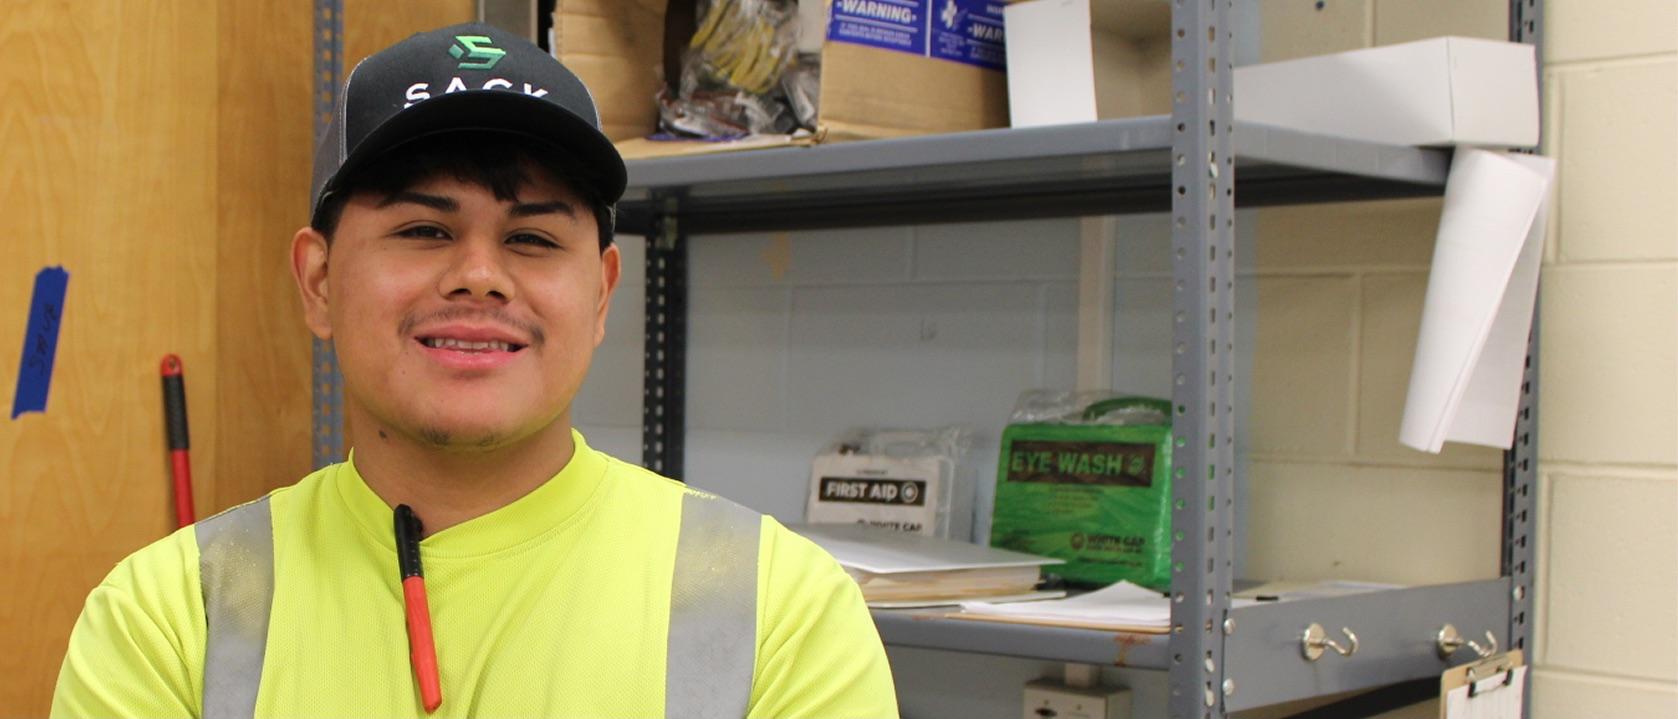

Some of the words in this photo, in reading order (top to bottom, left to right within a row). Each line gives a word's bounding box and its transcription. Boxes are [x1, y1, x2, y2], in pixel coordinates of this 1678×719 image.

[973, 22, 1004, 42] WAR
[1011, 451, 1053, 473] EYE
[1058, 452, 1123, 475] WASH
[826, 481, 868, 499] FIRST
[869, 483, 898, 500] AID
